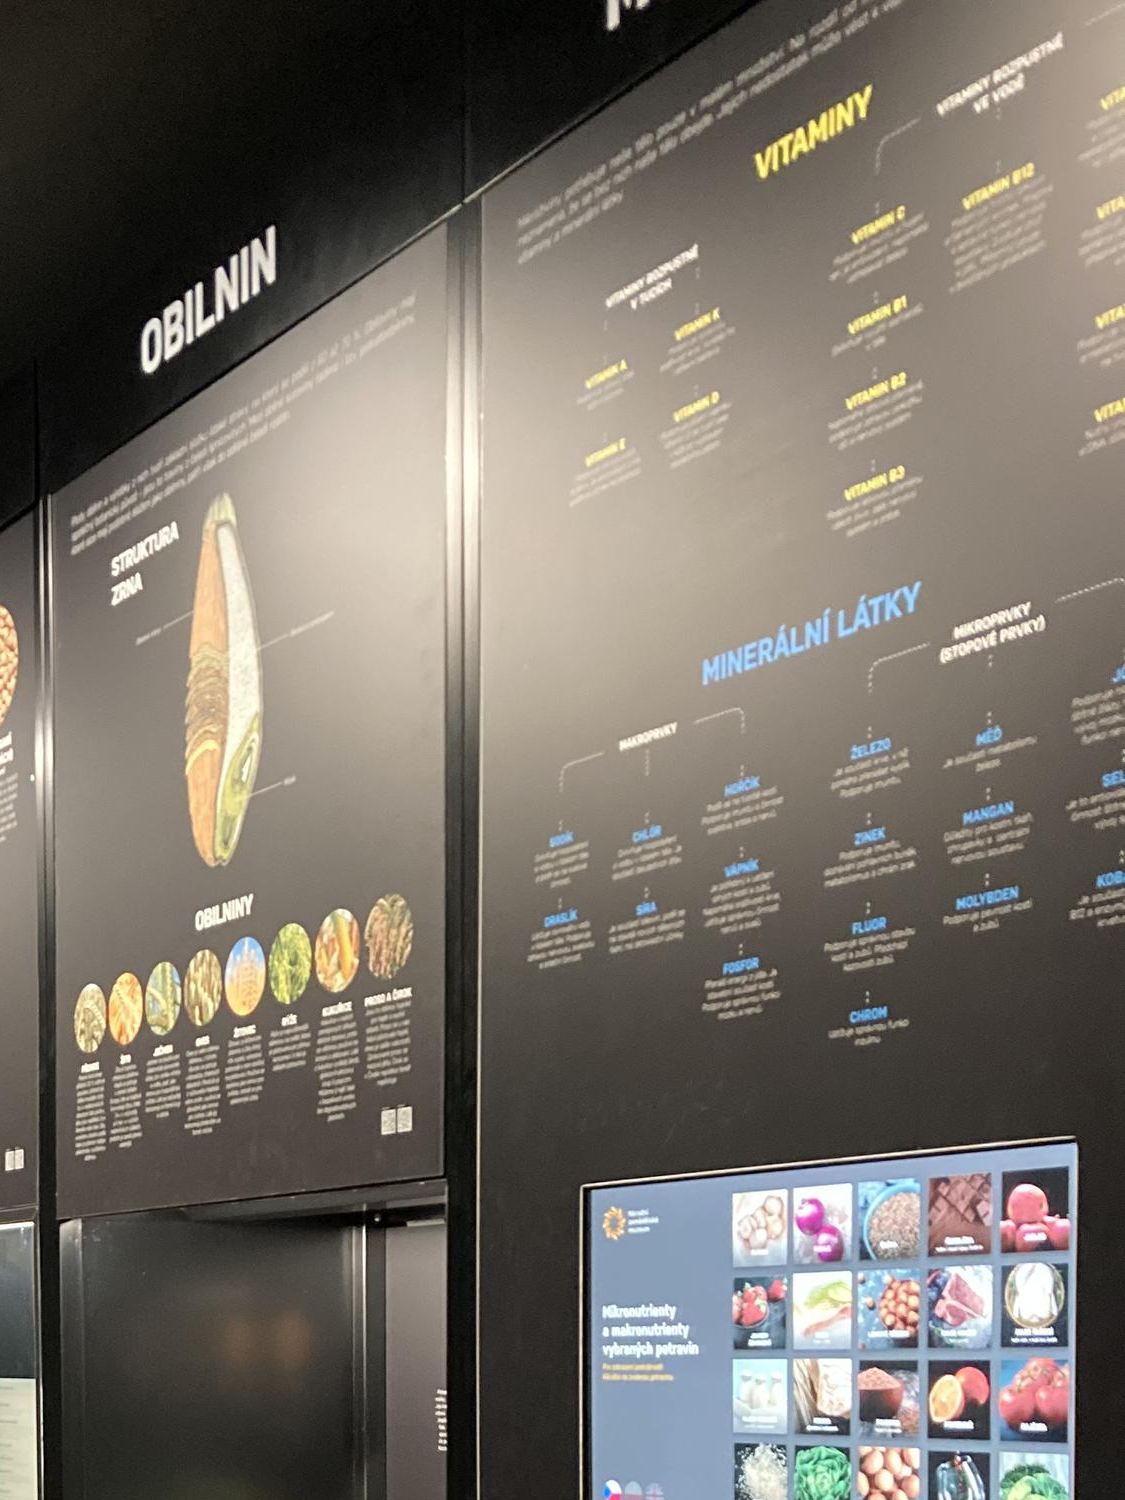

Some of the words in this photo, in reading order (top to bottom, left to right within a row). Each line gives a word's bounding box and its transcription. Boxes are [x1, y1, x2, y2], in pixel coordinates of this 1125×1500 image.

[753, 83, 874, 180] VITAMINY
[961, 175, 1011, 211] VITAMIN
[851, 212, 894, 244] VITAMIN
[139, 225, 279, 376] OBILNIN
[847, 304, 890, 335] VITAMIN
[844, 379, 889, 410] VITAMIN
[843, 472, 888, 501] VITAMIN
[110, 520, 180, 577] STRUKTURA
[110, 572, 145, 606] ZRNA
[701, 608, 833, 687] MINERÁLNÍ
[835, 580, 924, 641] LÁTKY
[953, 601, 1033, 641] MIKROPRVKY
[939, 630, 998, 665] (STOPOVÉ
[998, 614, 1047, 644] PRVKY)
[849, 737, 892, 760] ŽELEZO
[962, 800, 1015, 826] MANGAN
[853, 826, 886, 846] ZINEK
[194, 893, 255, 931] OBILNINY
[955, 886, 1020, 911] MOLYBDEN
[851, 916, 887, 935] FLUOR
[848, 1005, 889, 1024] CHROM
[603, 1304, 676, 1320] Mikronutrienty
[602, 1326, 610, 1338] a
[611, 1323, 689, 1338] makronutrienty
[603, 1343, 653, 1358] vybraných
[656, 1341, 699, 1358] potravin
